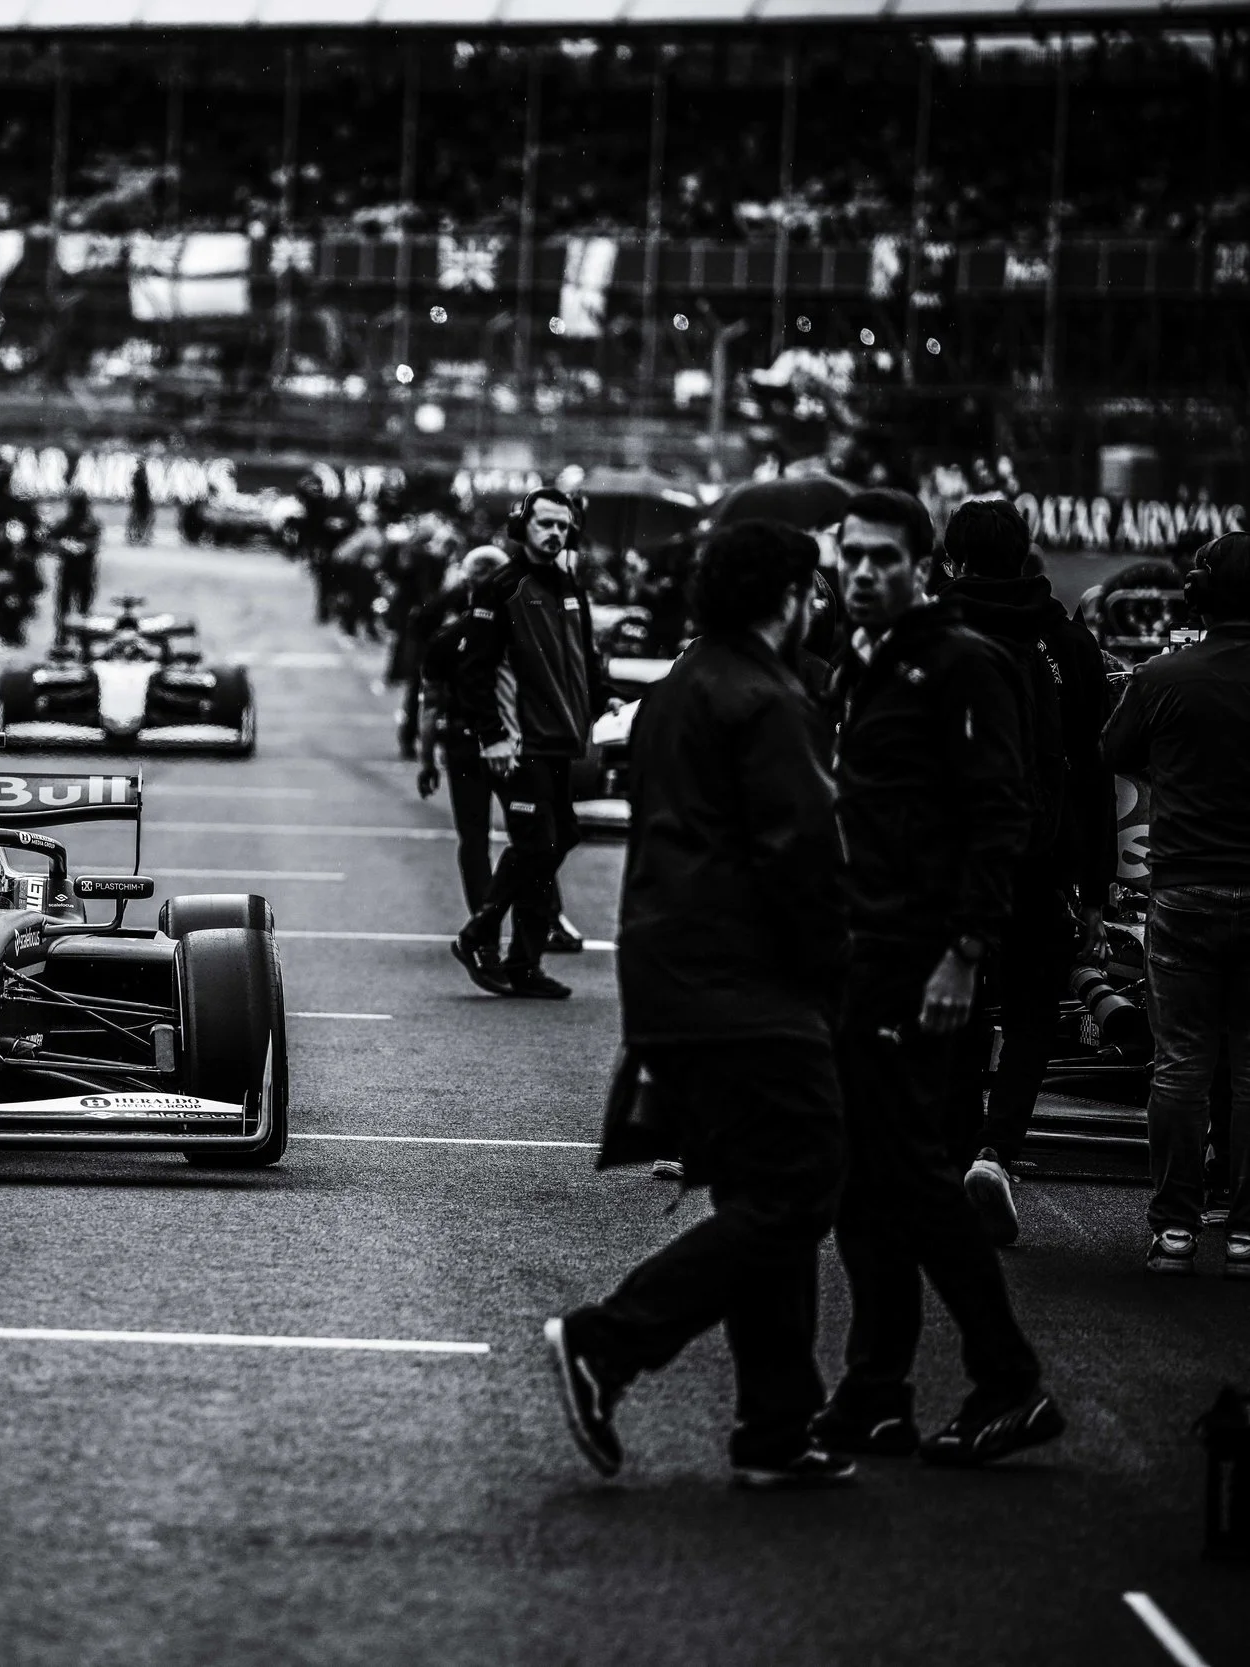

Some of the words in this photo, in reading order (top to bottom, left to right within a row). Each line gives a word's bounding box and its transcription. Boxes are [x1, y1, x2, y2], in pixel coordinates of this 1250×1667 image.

[1014, 492, 1111, 549] QATAR
[95, 882, 145, 892] PLASTCHIM-T
[124, 1111, 237, 1119] scalefocus
